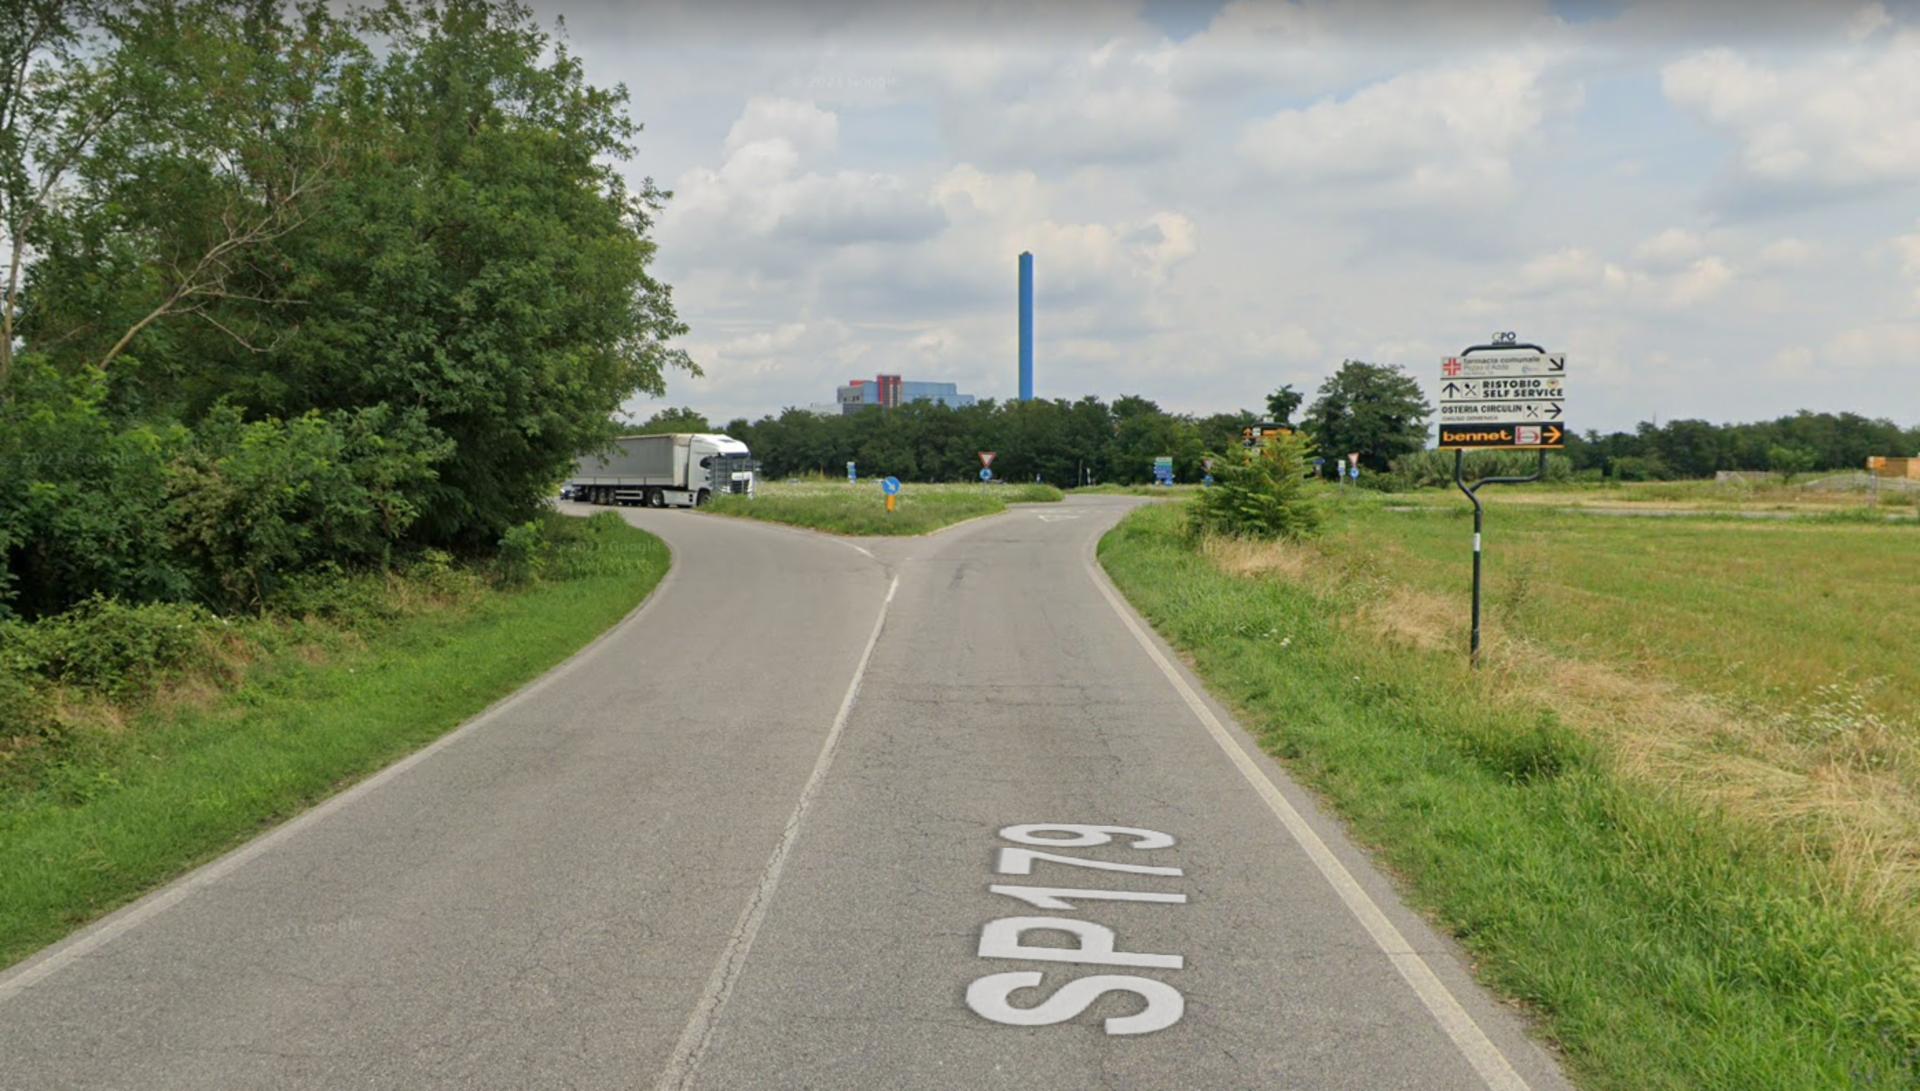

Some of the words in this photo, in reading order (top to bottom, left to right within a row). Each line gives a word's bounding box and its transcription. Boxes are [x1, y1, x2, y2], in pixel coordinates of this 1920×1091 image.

[1482, 380, 1541, 389] RISTOBIO
[1482, 389, 1510, 398] SELF
[1513, 388, 1563, 397] SERVICE
[1441, 405, 1479, 414] OSTERIA
[1480, 404, 1522, 413] CIRCULIN
[1443, 430, 1512, 442] bennet
[965, 822, 1187, 1035] SP179
